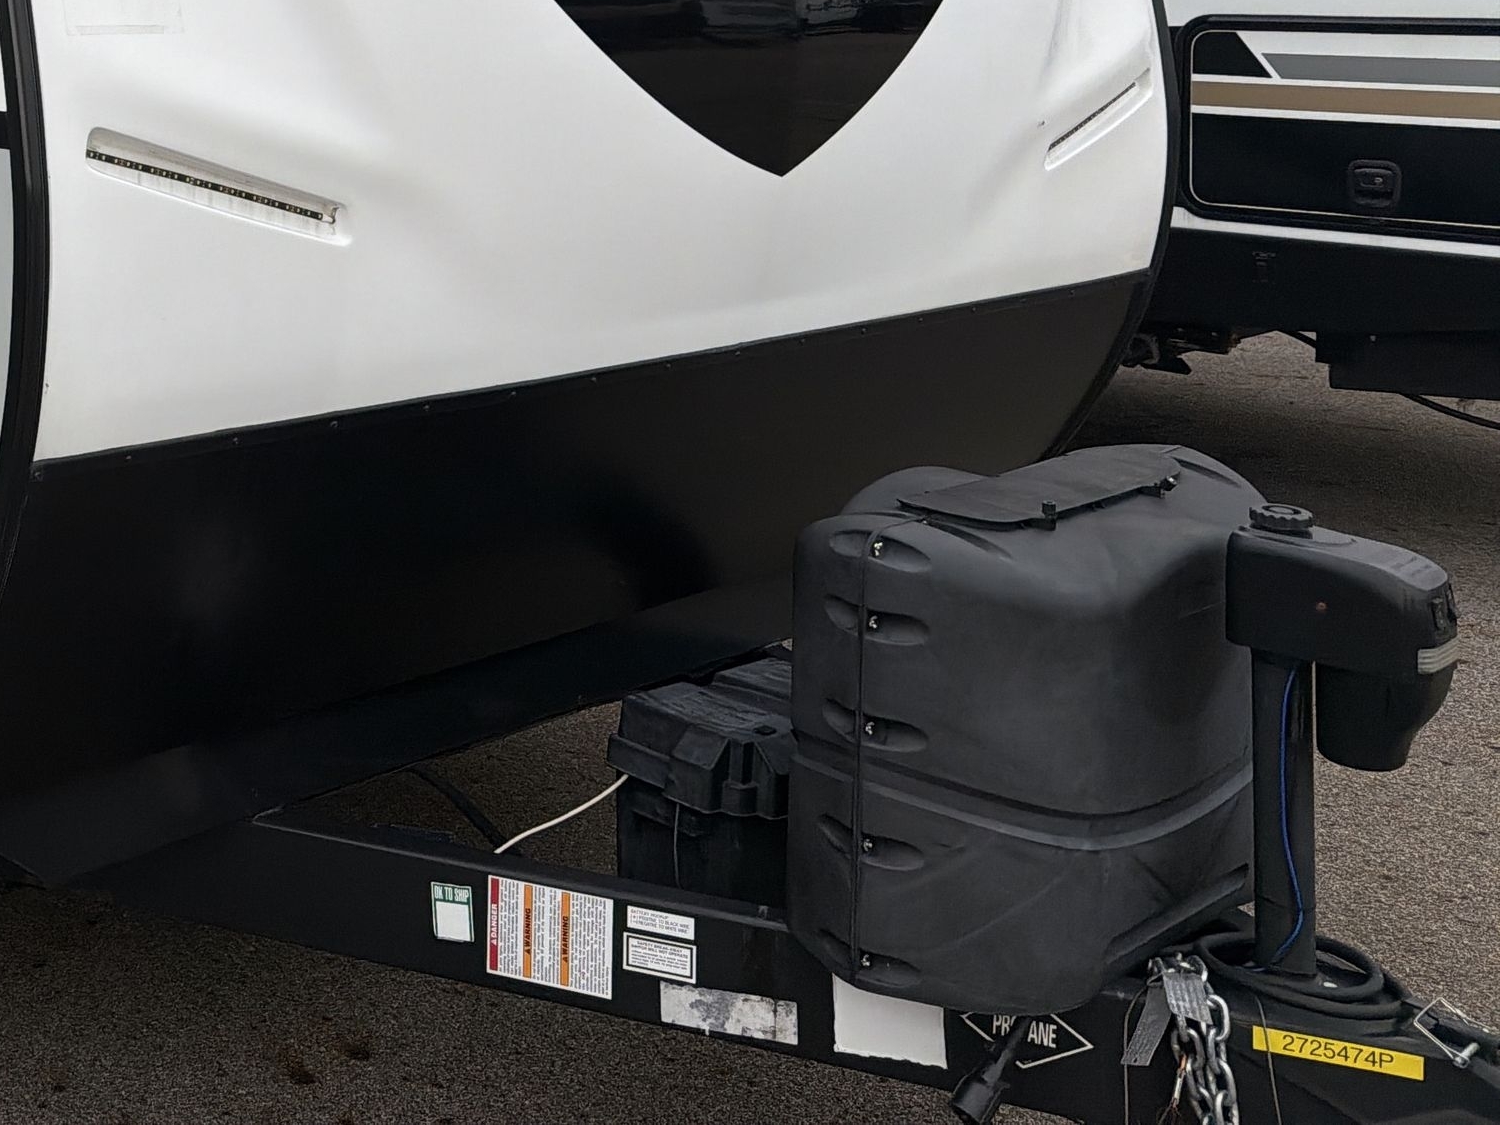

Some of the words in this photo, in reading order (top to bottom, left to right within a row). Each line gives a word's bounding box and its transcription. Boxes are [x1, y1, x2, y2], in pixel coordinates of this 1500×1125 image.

[434, 885, 443, 900] OK
[444, 887, 453, 901] TO
[454, 888, 469, 903] SHIP
[992, 1014, 1058, 1049] PRANE
[1282, 1034, 1394, 1068] 2725474P
